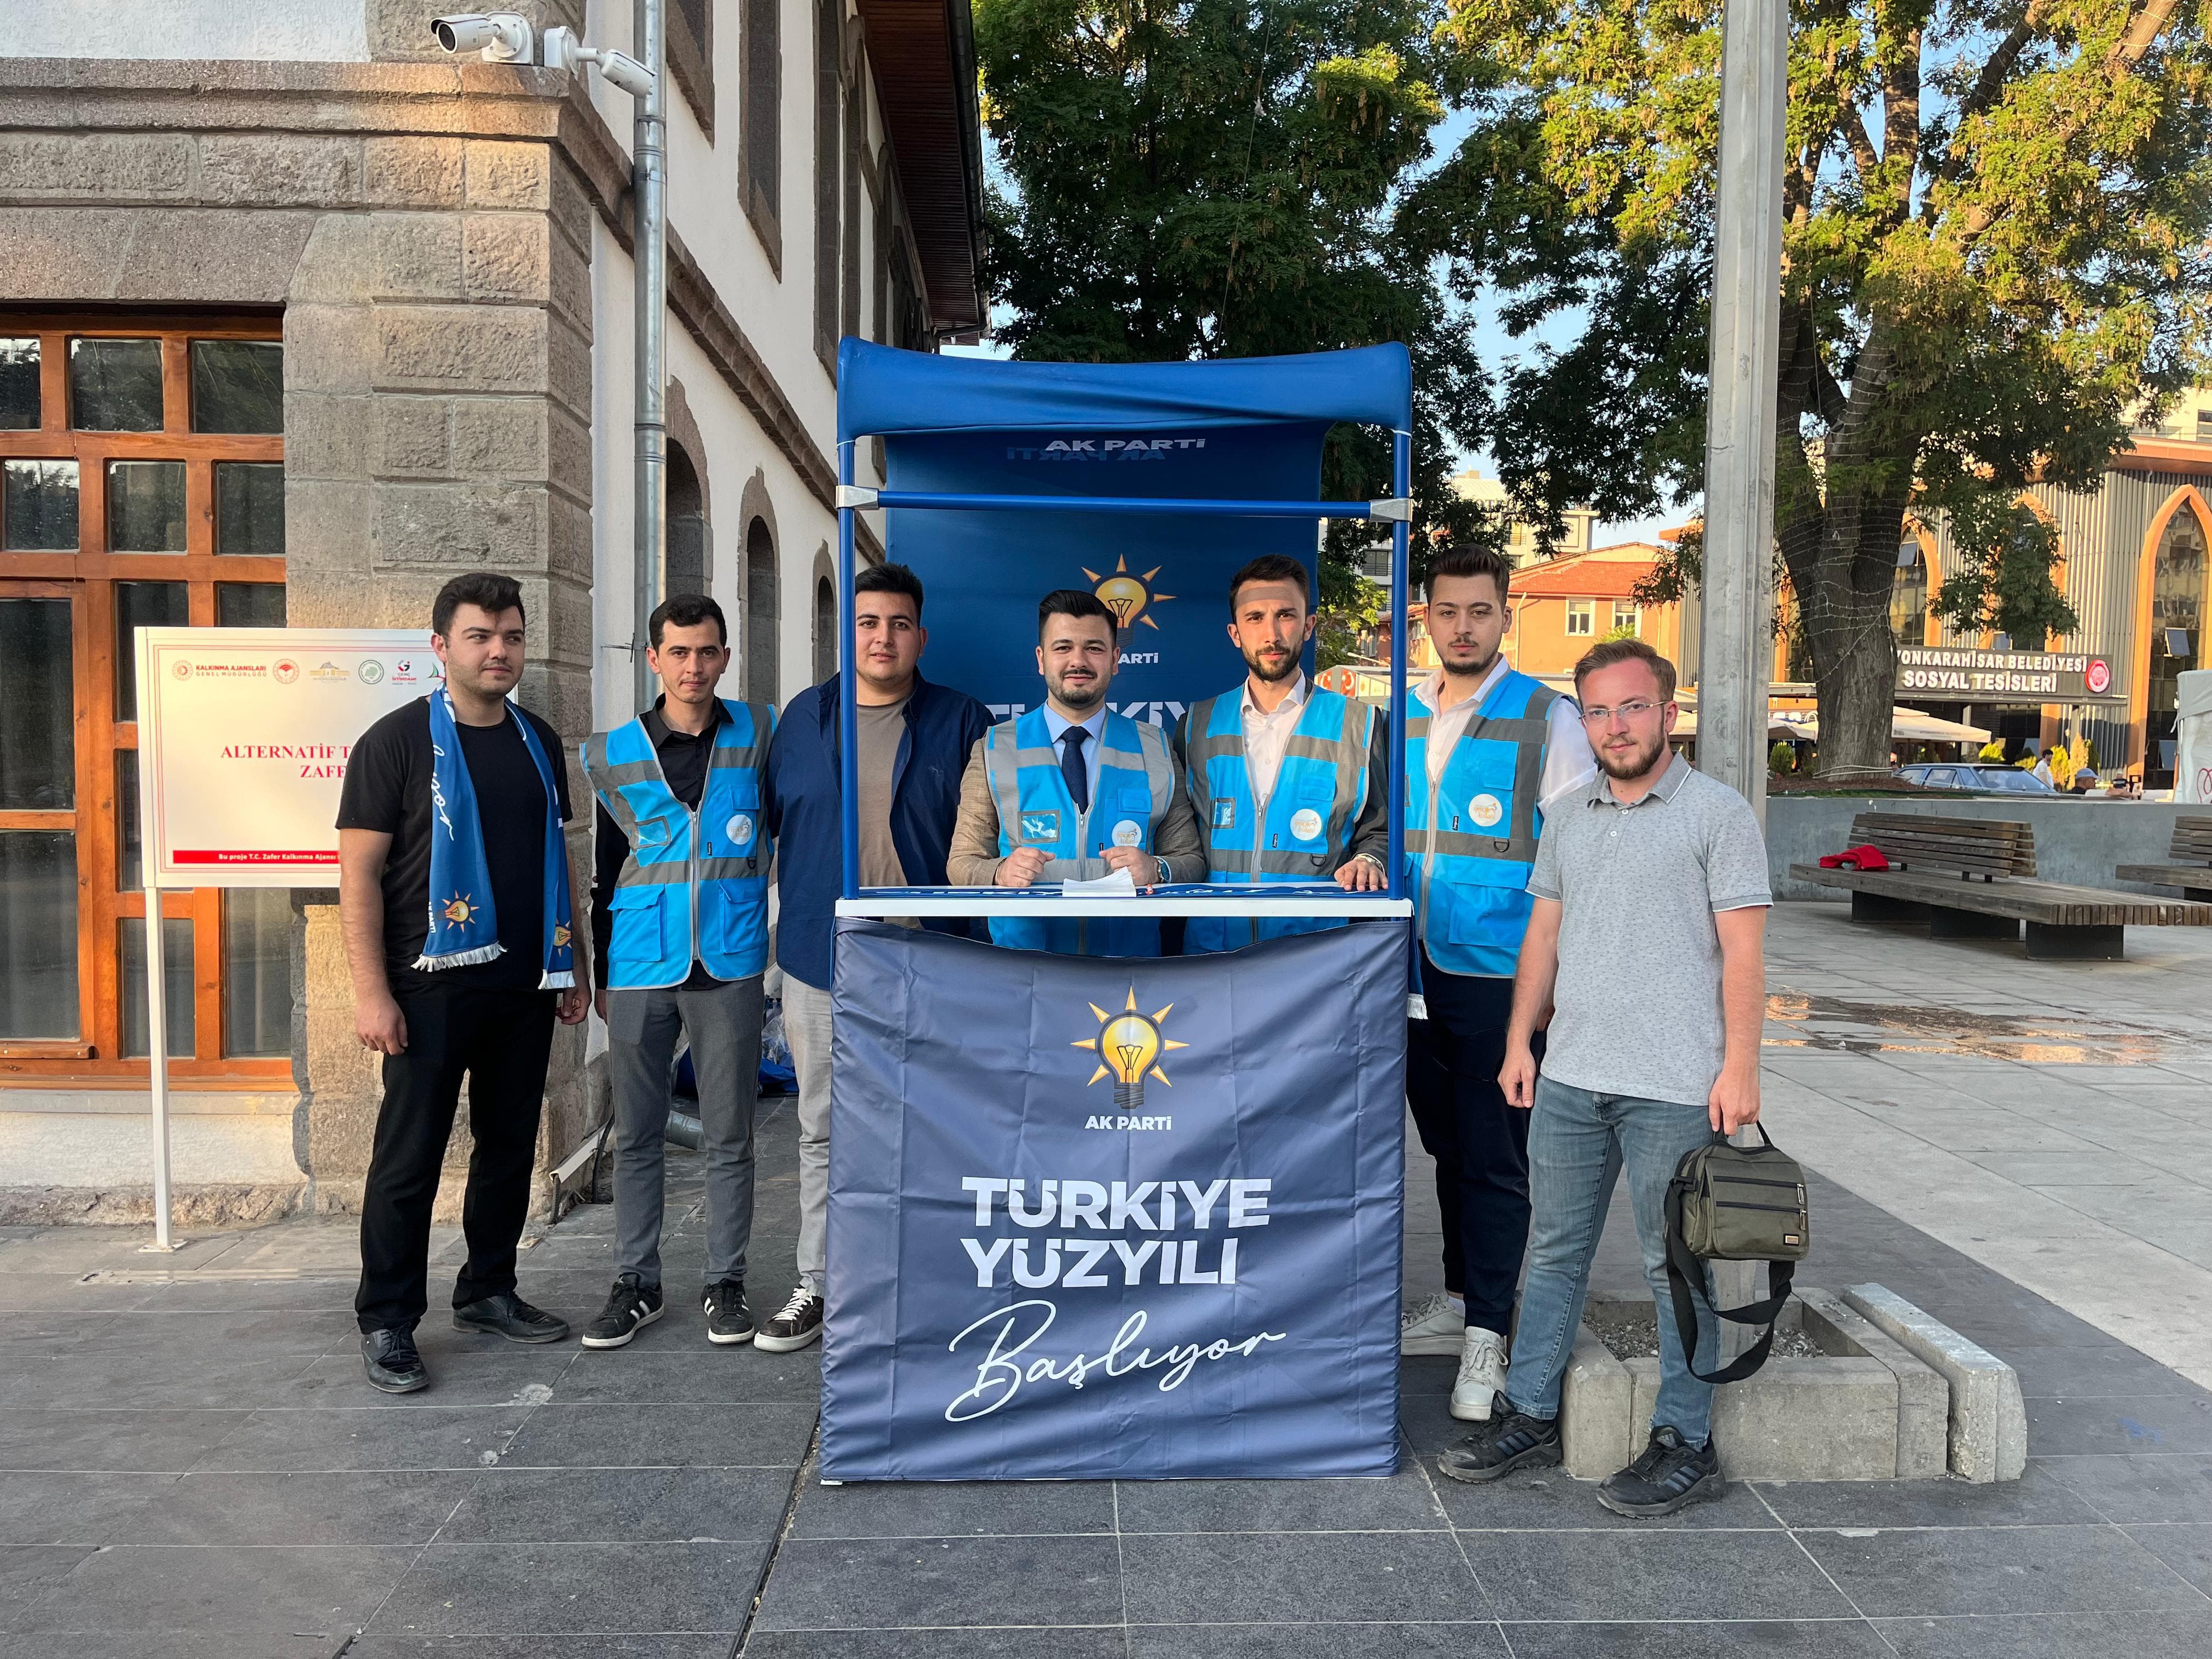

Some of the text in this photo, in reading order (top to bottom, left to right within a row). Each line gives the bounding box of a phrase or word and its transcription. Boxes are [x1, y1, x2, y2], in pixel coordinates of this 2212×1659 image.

[1044, 440, 1096, 451] AK
[2008, 654, 2087, 673] BELEDİYESİ
[1903, 669, 2057, 693] SOSYAL TESİSLERİ
[221, 743, 336, 758] ALTERNATİF
[1084, 1115, 1114, 1130] AK
[961, 1176, 1273, 1231] TÜRKİYE
[960, 1237, 1239, 1288] YÜZYILI
[944, 1299, 1286, 1423] Başlıyor
